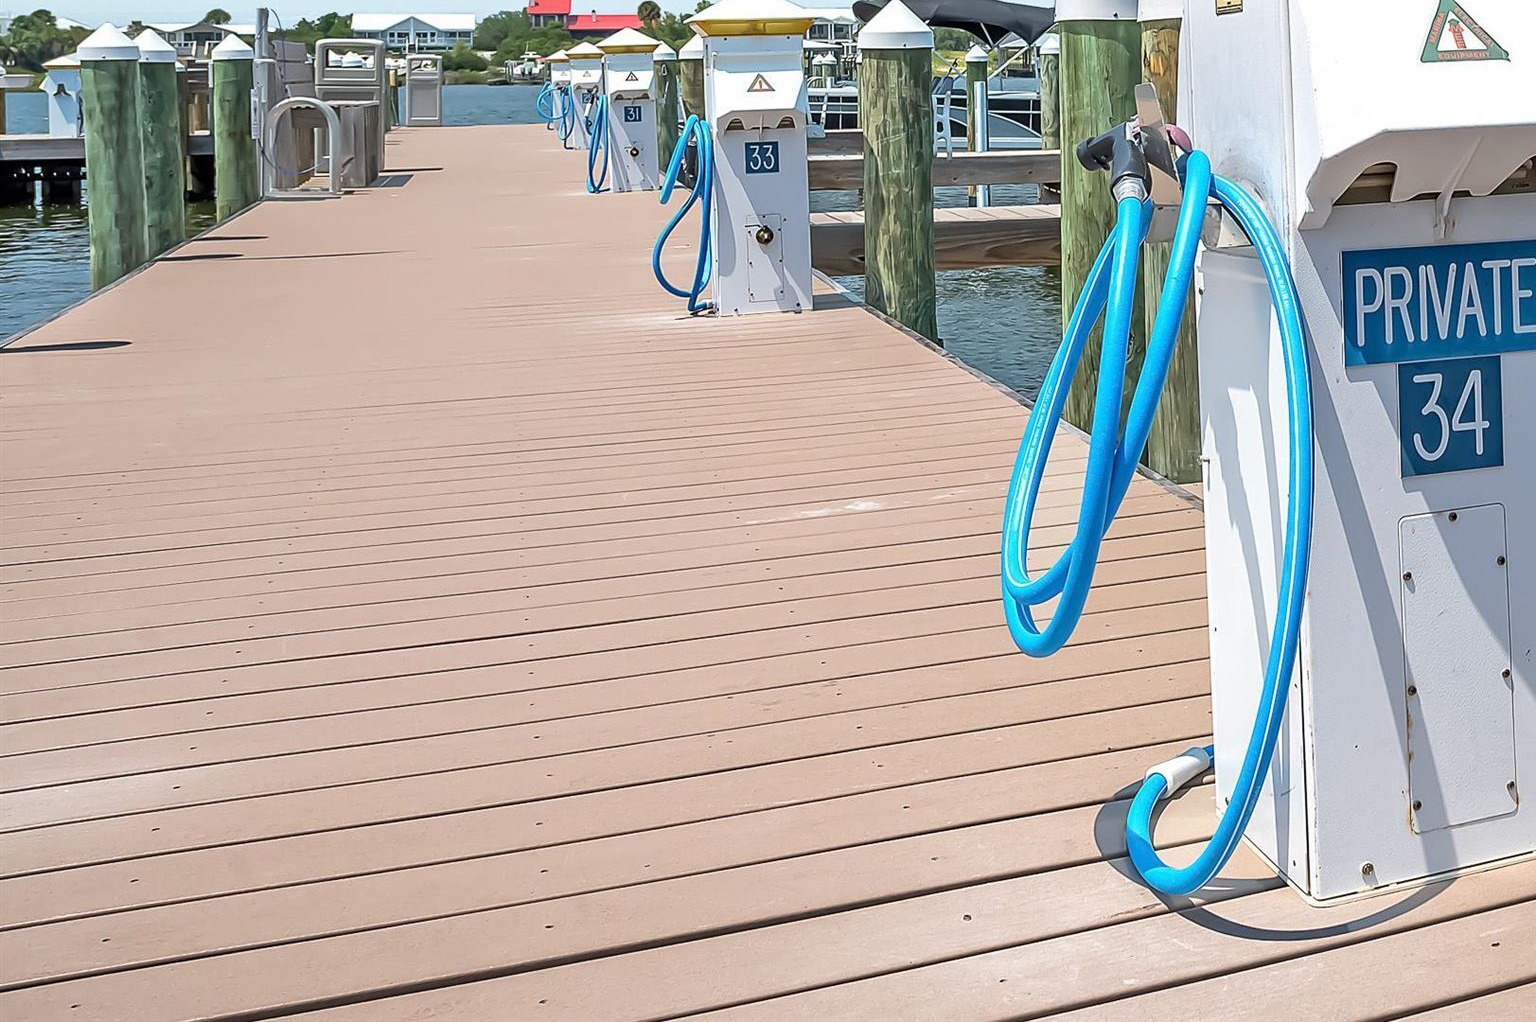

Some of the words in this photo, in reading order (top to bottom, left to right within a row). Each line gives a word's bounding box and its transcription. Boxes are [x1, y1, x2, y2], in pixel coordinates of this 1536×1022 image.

[1429, 11, 1445, 44] MARINA
[1453, 5, 1496, 48] ELECTRICAL
[1438, 51, 1490, 59] EQUIPMENT
[627, 107, 639, 121] 31
[749, 145, 775, 170] 33
[1412, 369, 1490, 462] 34
